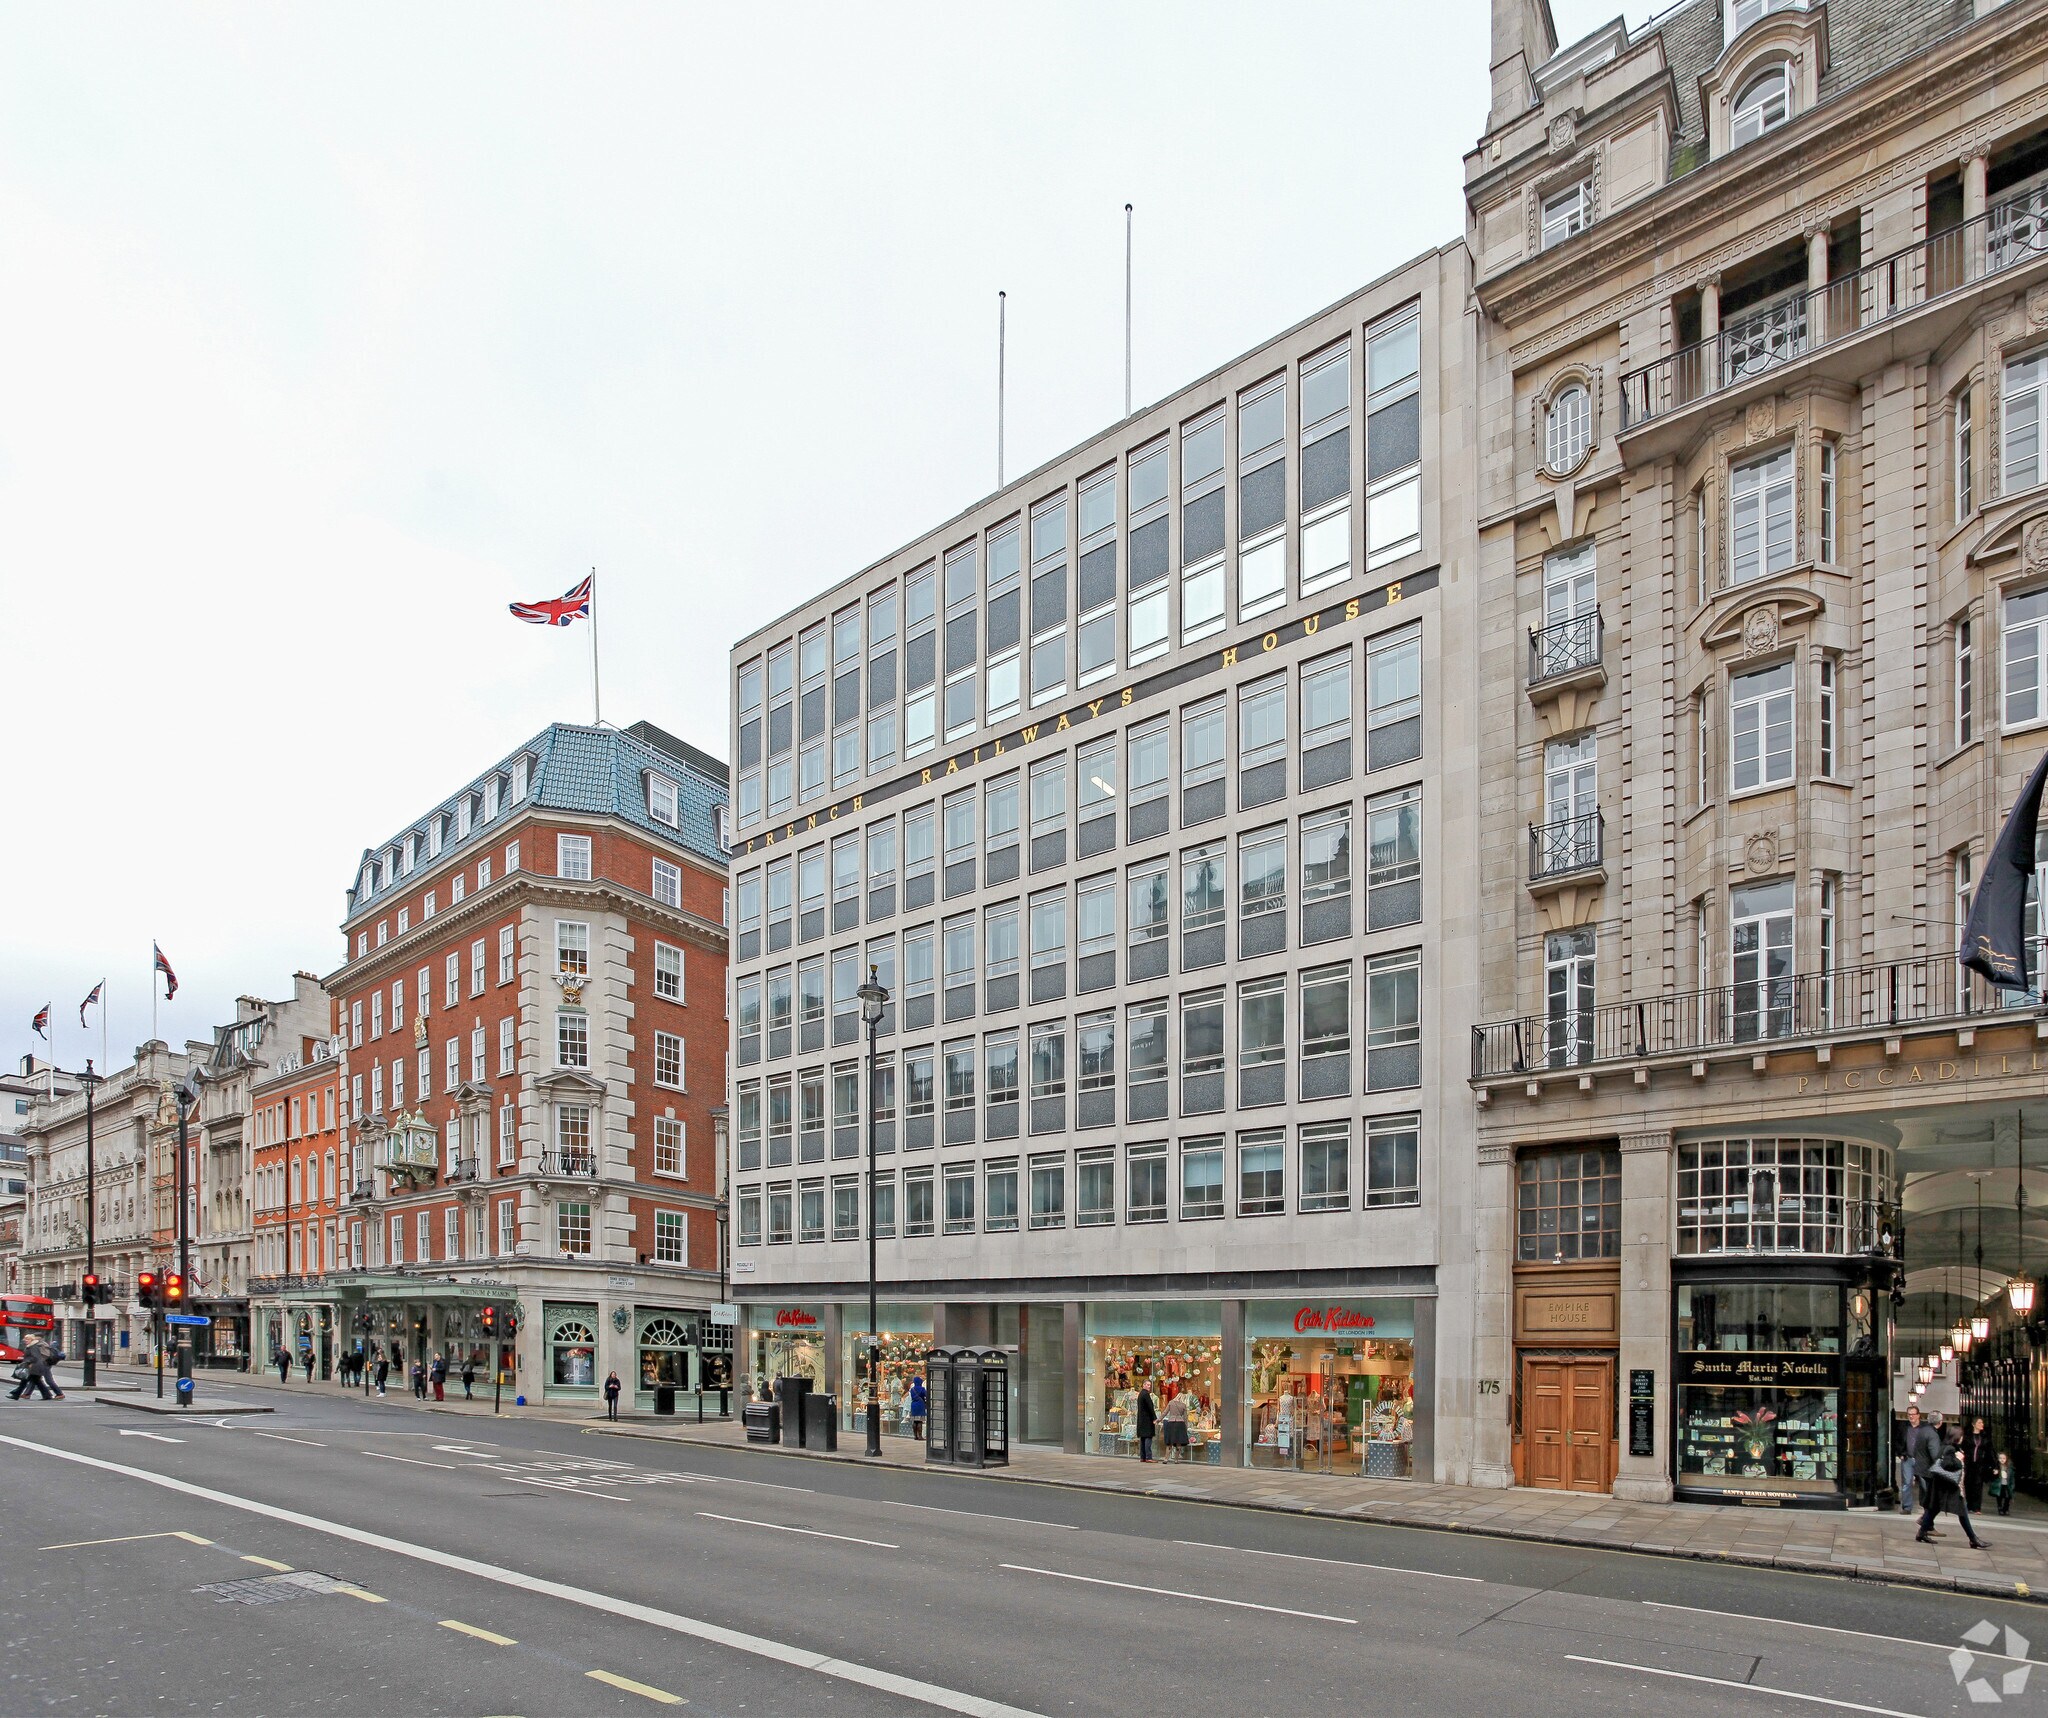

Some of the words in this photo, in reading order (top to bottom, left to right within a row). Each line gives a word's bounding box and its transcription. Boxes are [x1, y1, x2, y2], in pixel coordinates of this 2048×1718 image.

[746, 796, 863, 855] FRENCH
[921, 687, 1133, 785] RAILWAYS
[1222, 582, 1402, 669] HOUSE
[1547, 1302, 1590, 1312] EMPIRE
[776, 1309, 792, 1327] Cath
[790, 1308, 817, 1326] Kidston
[1293, 1307, 1323, 1333] Cath
[1323, 1306, 1376, 1331] Kidston
[1550, 1313, 1587, 1323] HOUSE
[1692, 1360, 1732, 1374] Santa
[1736, 1360, 1778, 1375] Maria
[1782, 1361, 1827, 1376] Novella
[1478, 1380, 1500, 1394] 175
[458, 1460, 635, 1473] TURN
[522, 1472, 719, 1487] RIGHT
[1767, 1491, 1797, 1499] NOVELLA
